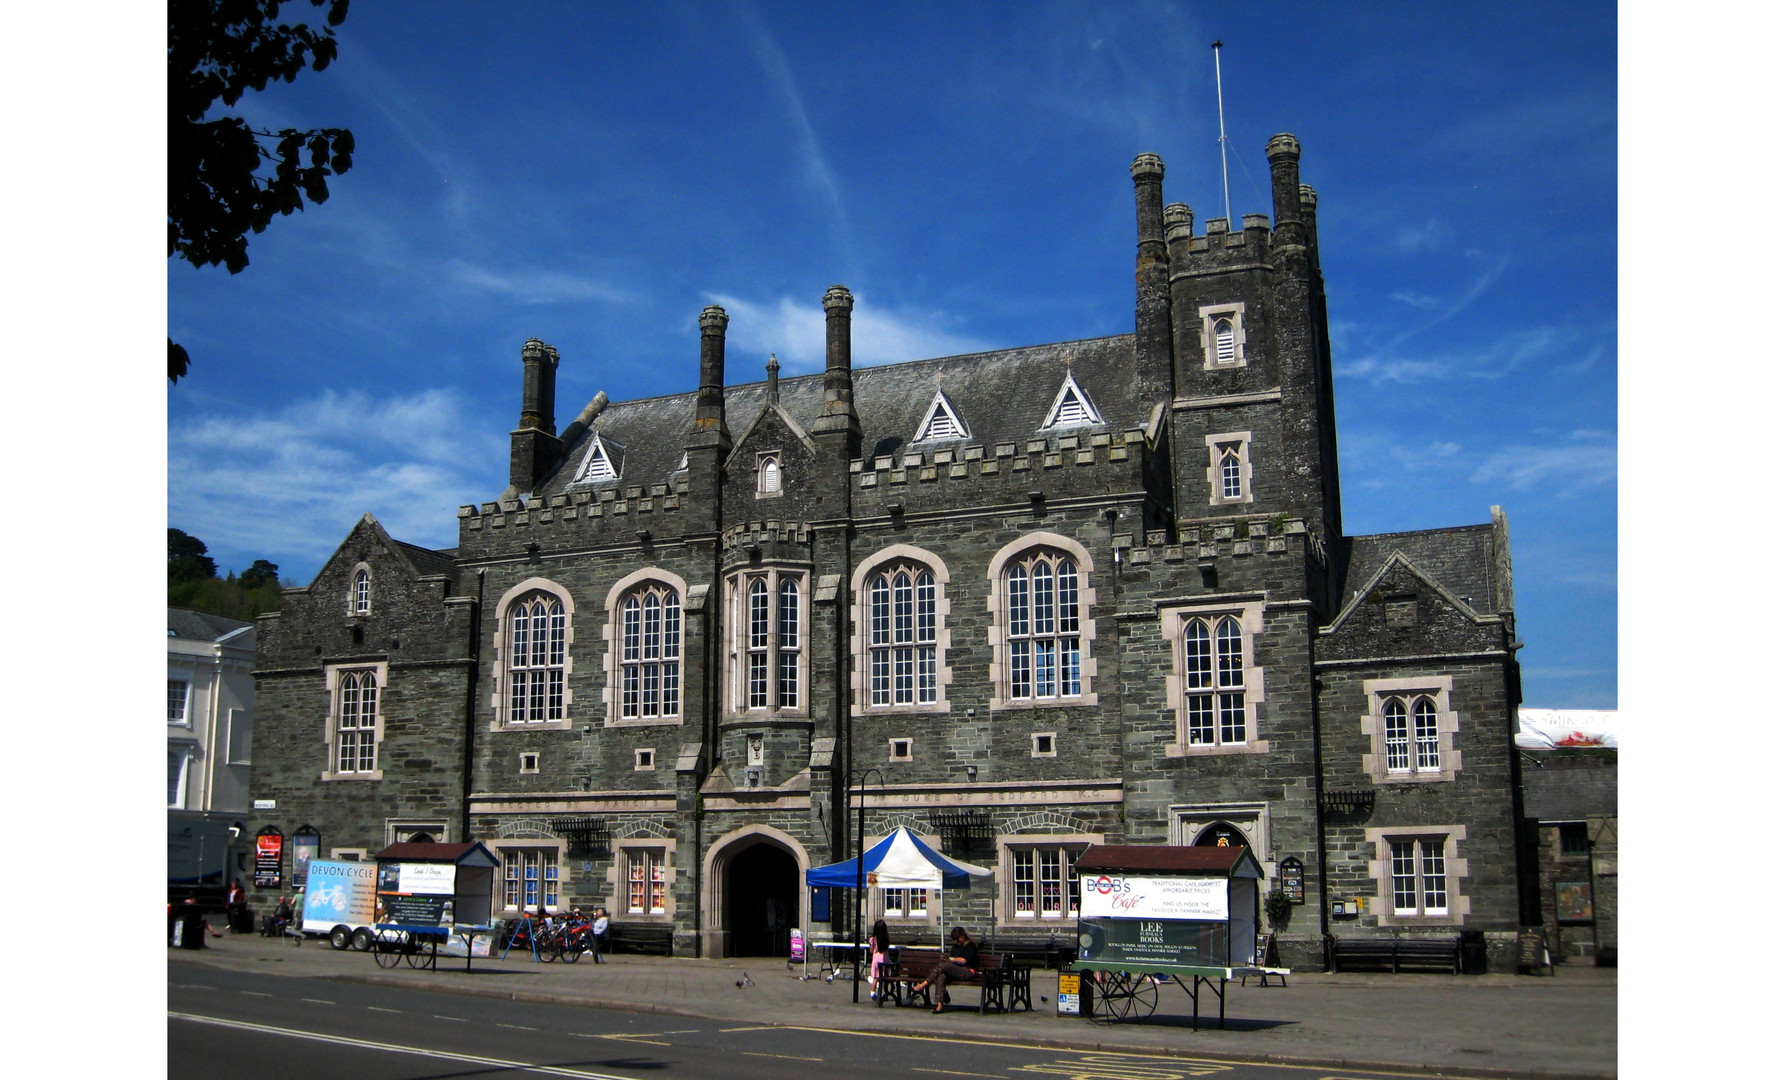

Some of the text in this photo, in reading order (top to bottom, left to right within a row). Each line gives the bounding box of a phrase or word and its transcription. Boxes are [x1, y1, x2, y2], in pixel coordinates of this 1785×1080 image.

[311, 865, 374, 879] DEVON CYCLE
[1140, 922, 1164, 932] LEE
